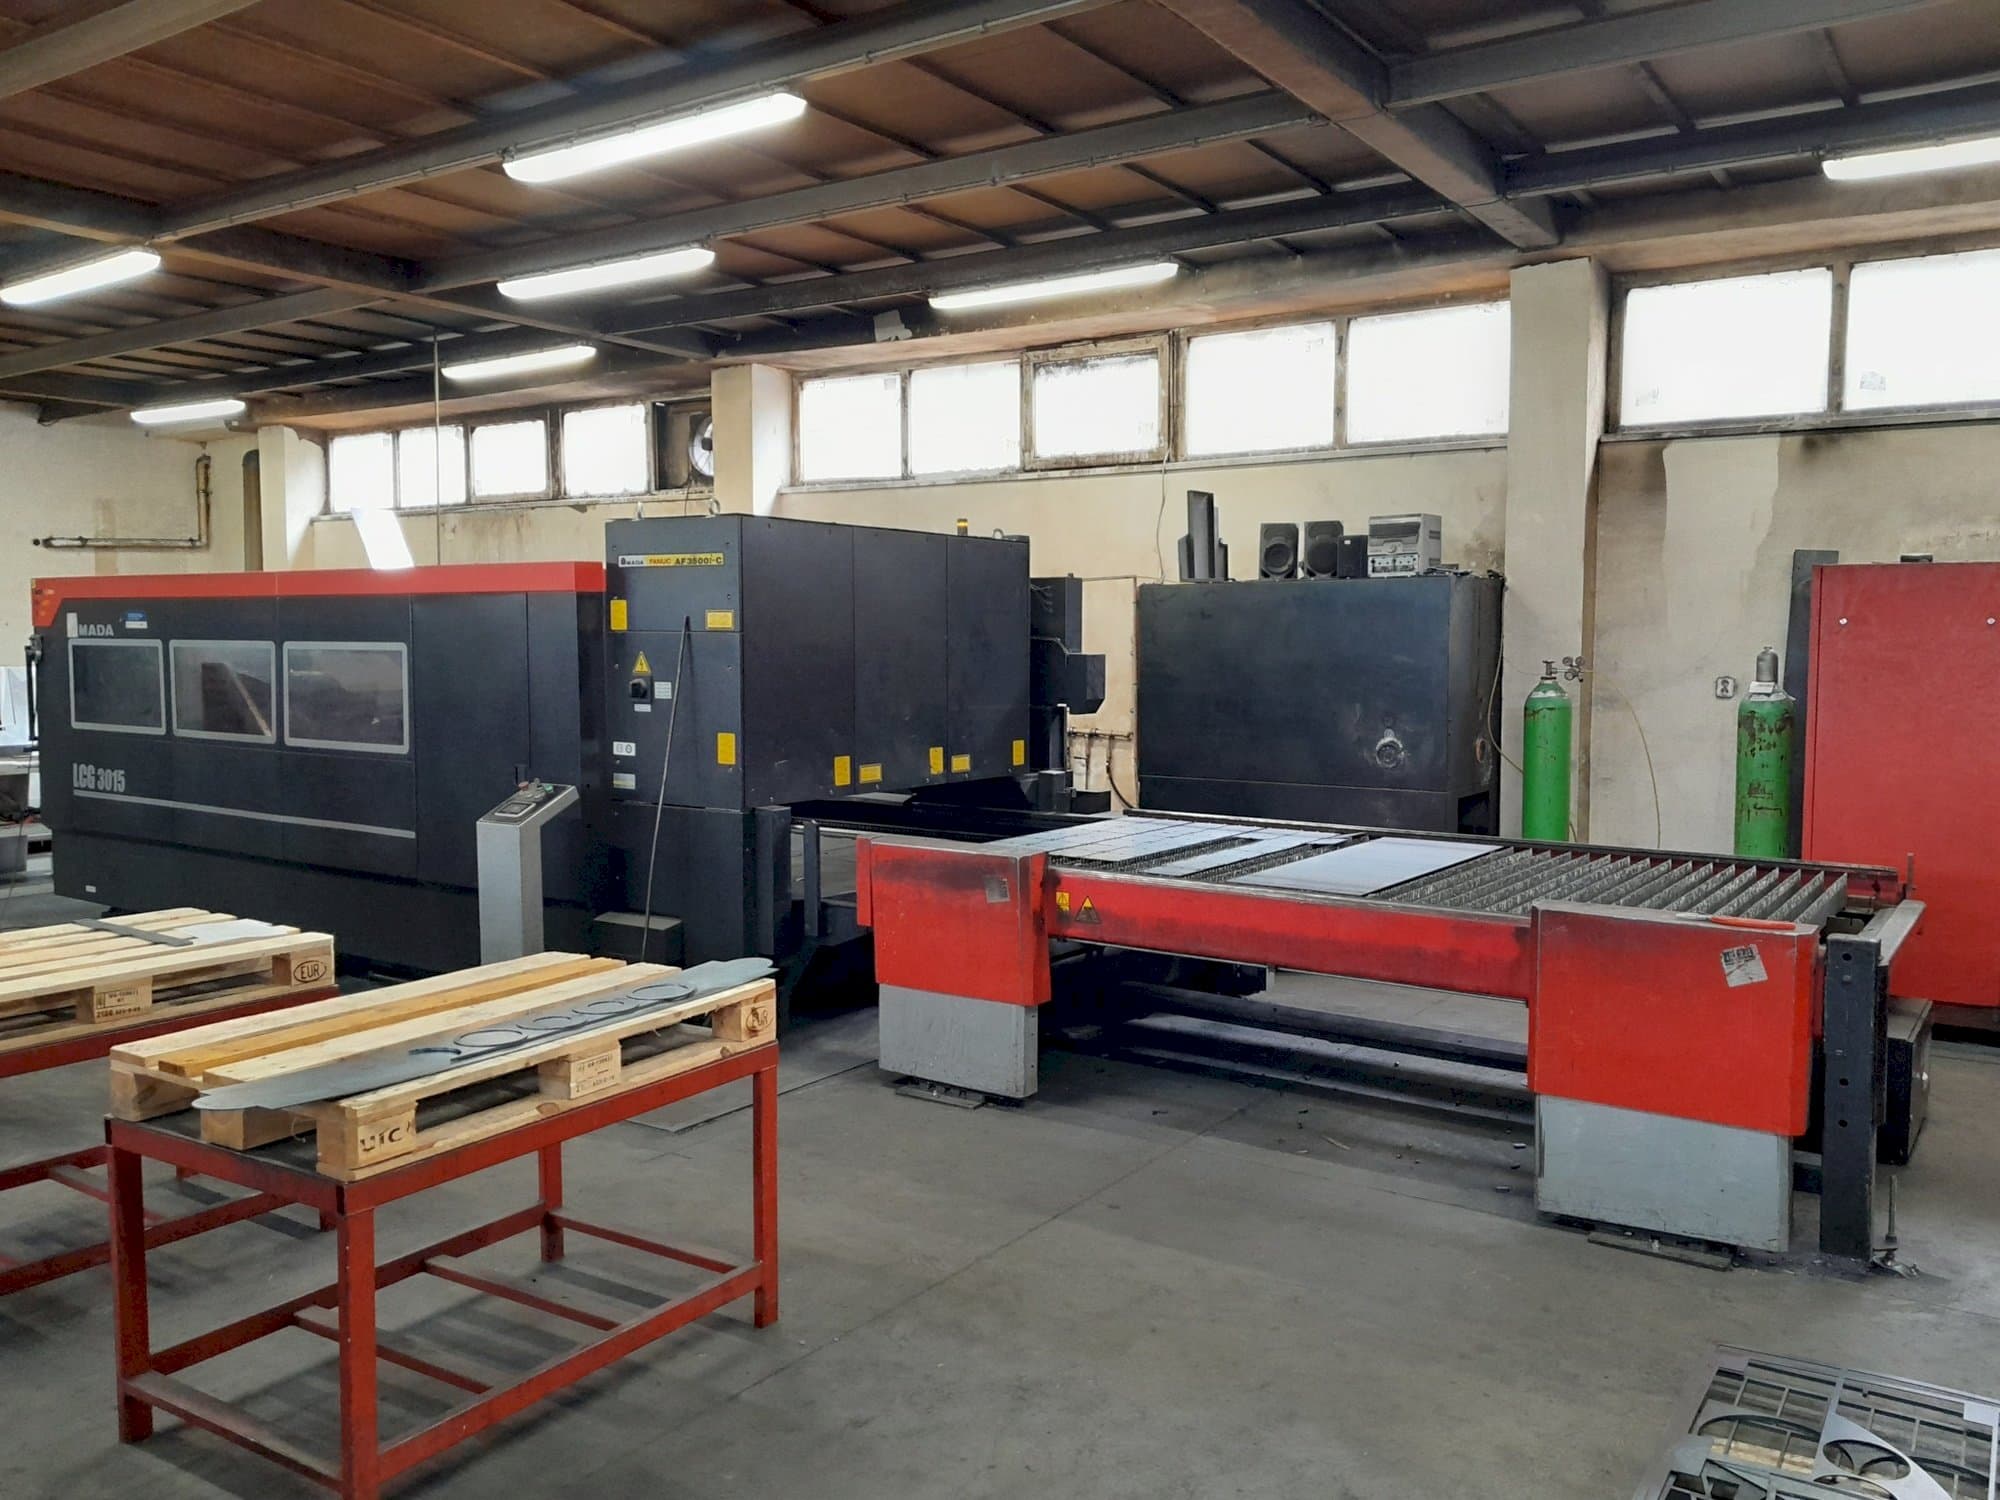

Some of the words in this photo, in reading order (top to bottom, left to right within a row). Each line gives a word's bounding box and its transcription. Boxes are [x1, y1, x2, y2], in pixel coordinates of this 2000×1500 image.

[66, 612, 114, 638] MADA
[97, 767, 125, 792] 3015
[300, 963, 320, 979] EUR
